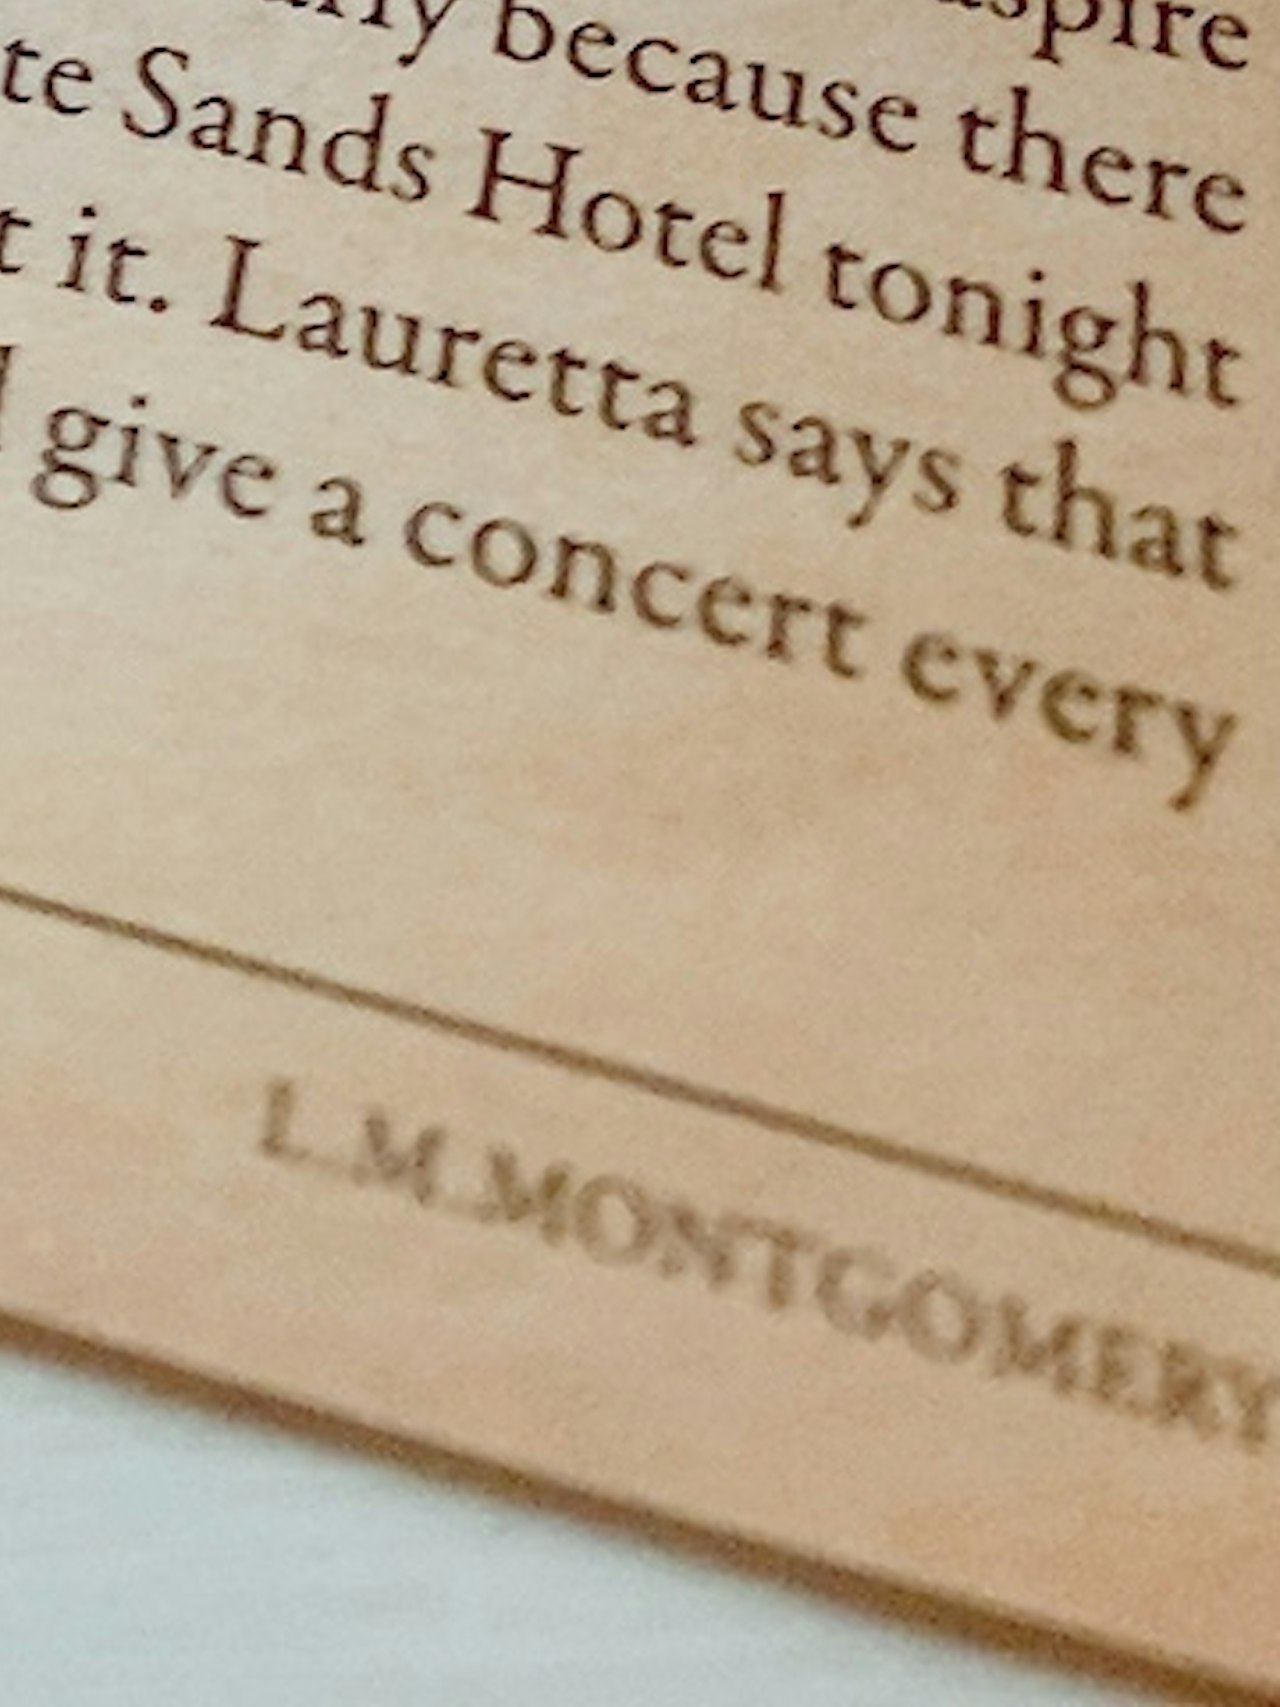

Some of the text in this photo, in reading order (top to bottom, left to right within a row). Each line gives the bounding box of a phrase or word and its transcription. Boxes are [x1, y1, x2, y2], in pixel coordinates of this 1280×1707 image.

[957, 84, 1247, 236] there
[56, 204, 171, 314] it.
[207, 234, 699, 449] Lauretta
[733, 401, 960, 530] says
[999, 437, 1239, 592] that
[403, 501, 868, 680] concert
[900, 633, 1237, 813] every
